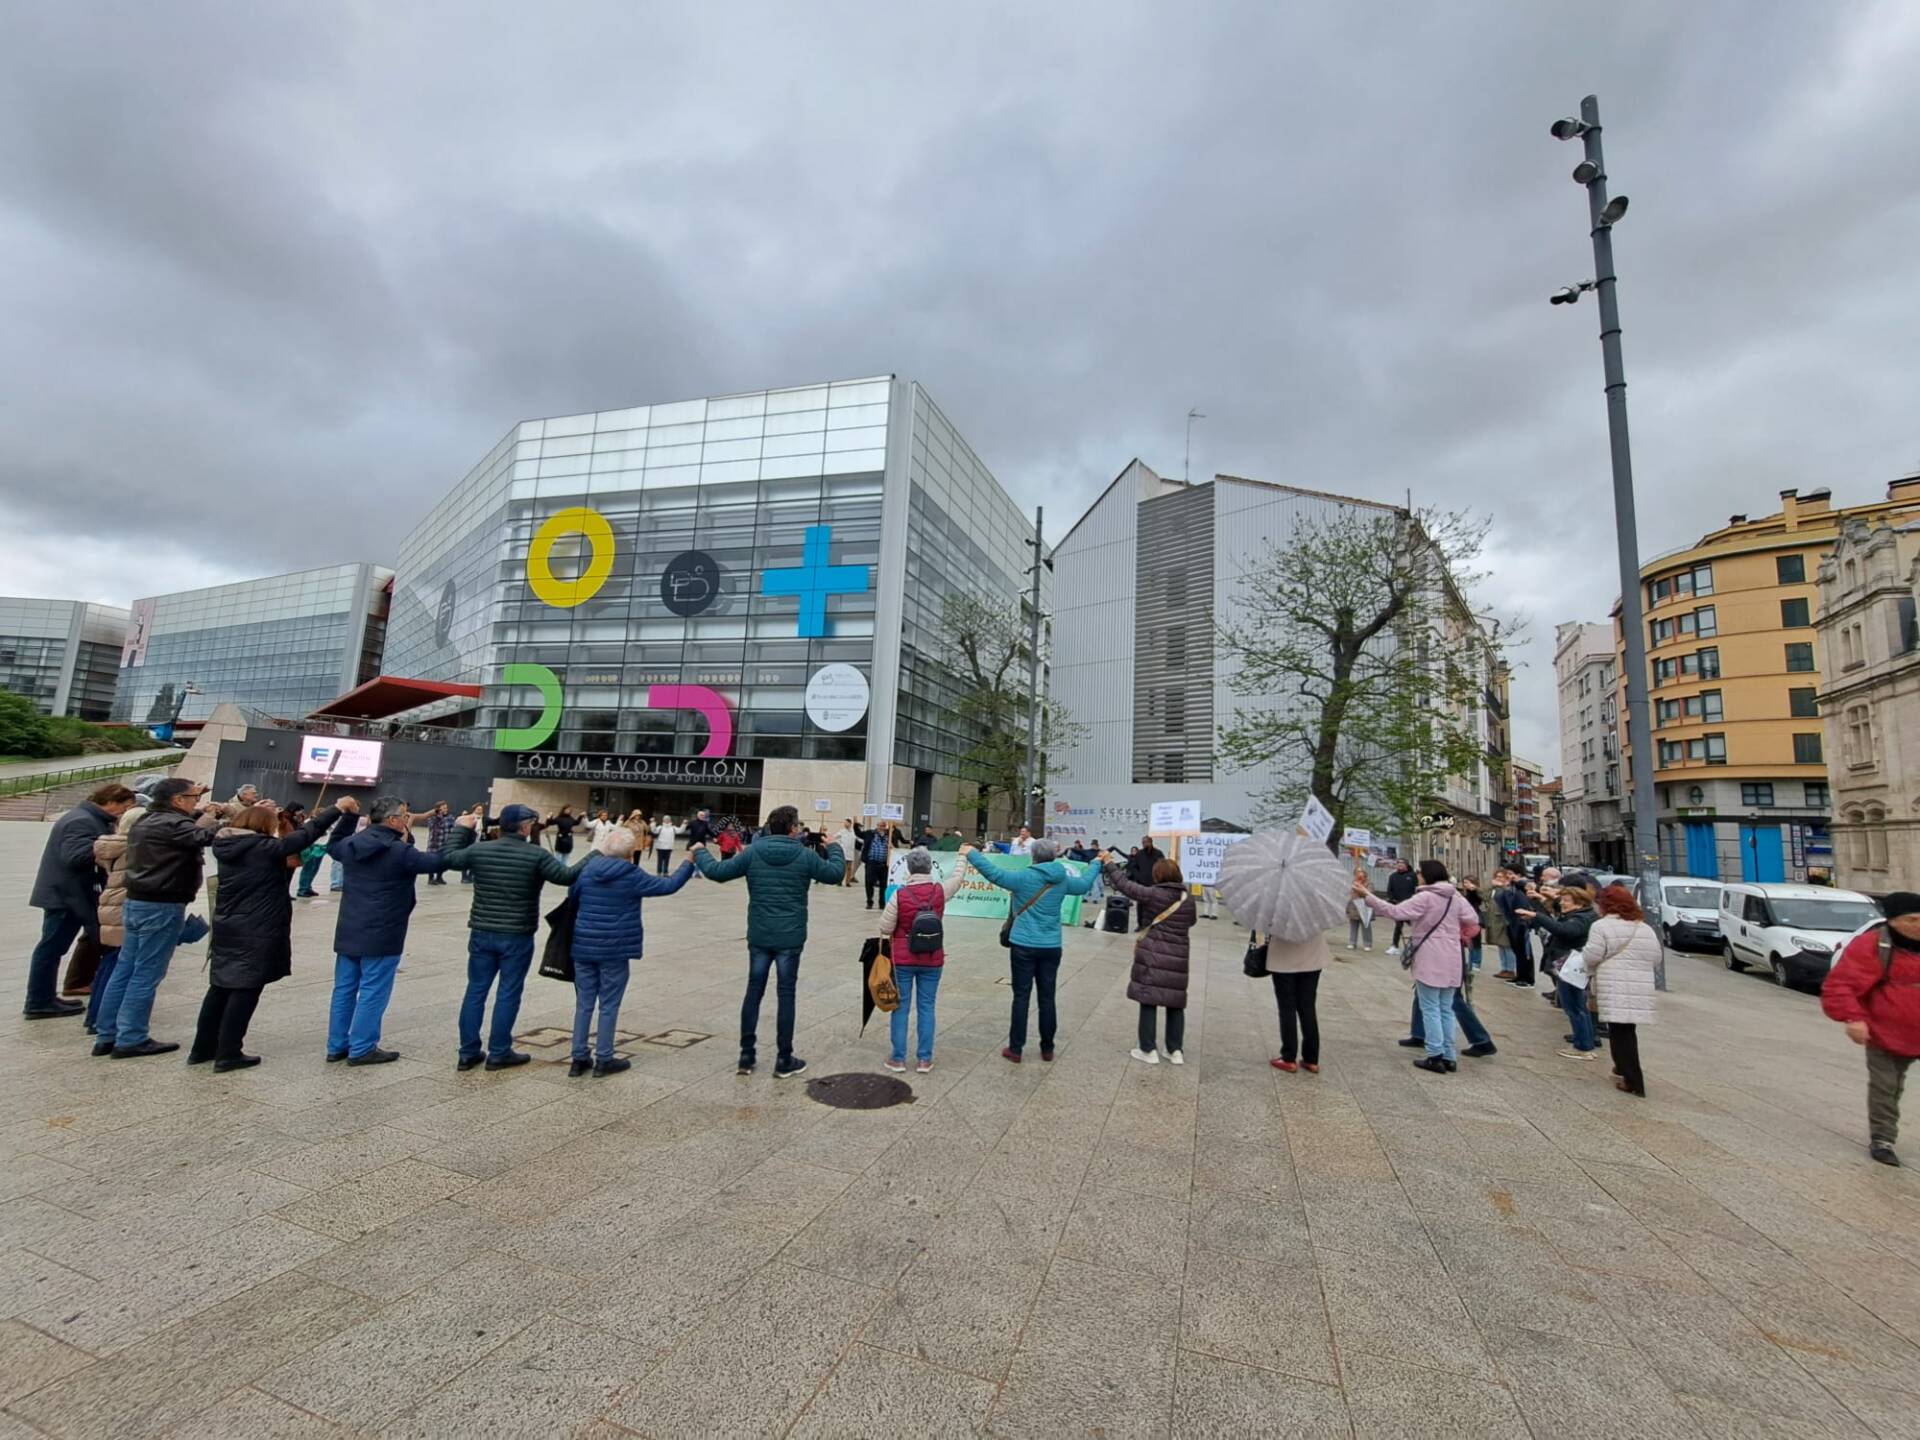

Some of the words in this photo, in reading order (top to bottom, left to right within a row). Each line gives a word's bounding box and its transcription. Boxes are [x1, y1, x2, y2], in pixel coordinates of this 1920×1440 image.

[516, 752, 588, 771] FÓRUM
[603, 757, 747, 777] EVOLUCIÓN
[515, 768, 561, 778] PALACIO
[566, 769, 579, 778] DE
[586, 770, 657, 781] CONGRESOS
[676, 774, 745, 784] AUDITORIO
[1187, 836, 1202, 845] DE
[1189, 847, 1205, 856] DE
[1189, 871, 1213, 880] para
